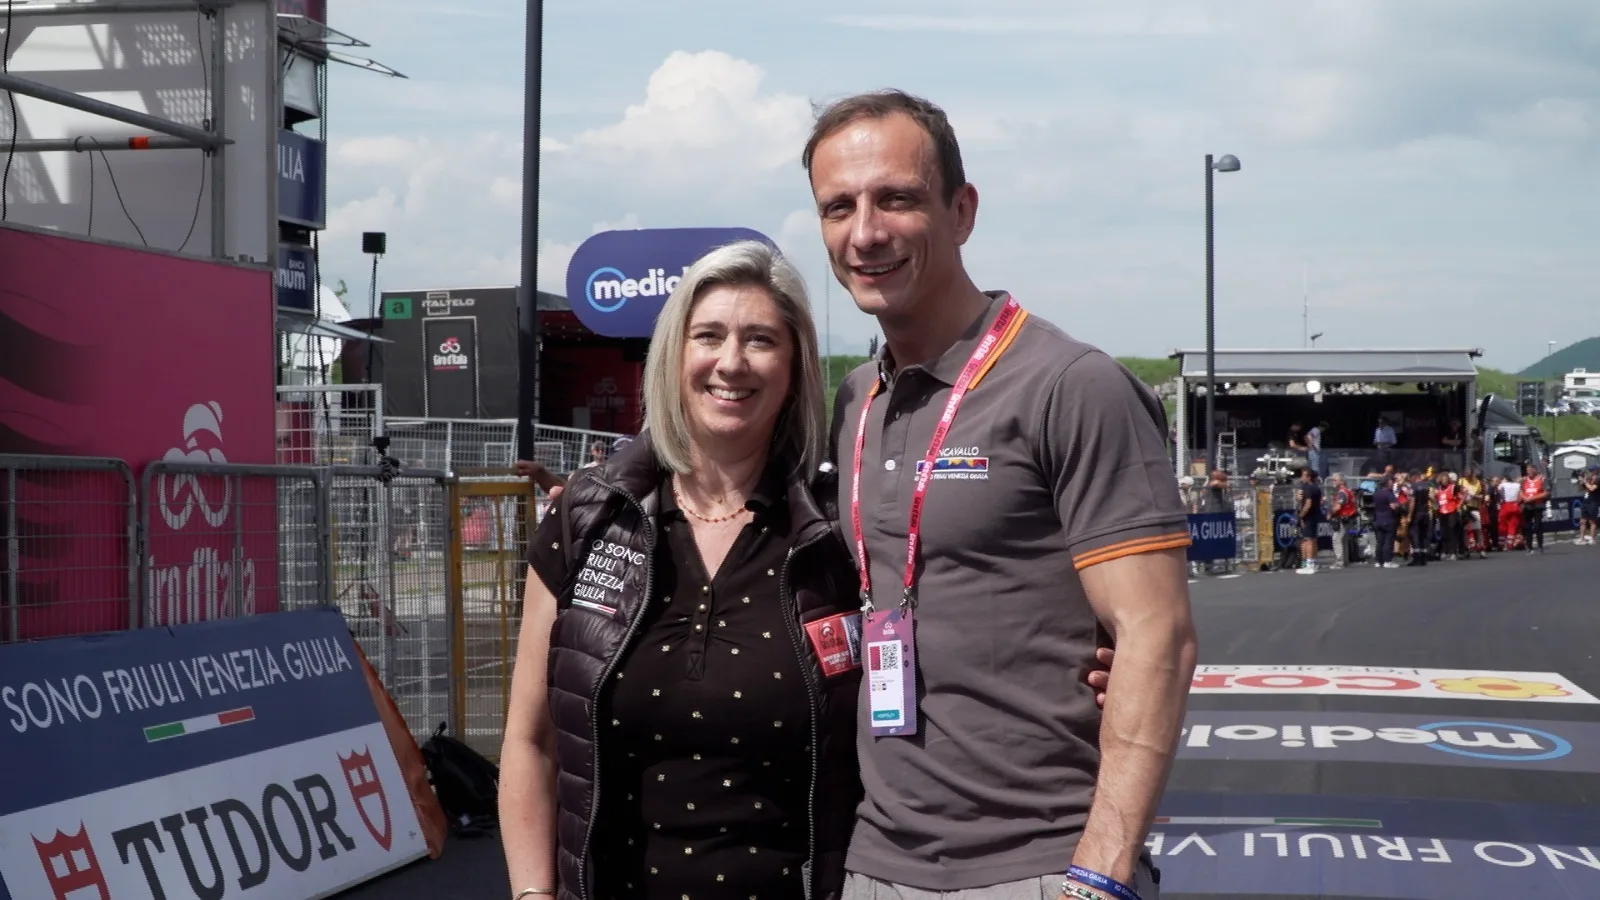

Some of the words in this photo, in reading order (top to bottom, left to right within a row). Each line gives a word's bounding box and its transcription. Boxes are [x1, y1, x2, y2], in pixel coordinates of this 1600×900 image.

[276, 268, 305, 290] num
[392, 301, 405, 314] a
[926, 446, 979, 457] NCAVALLO
[1200, 521, 1235, 540] GIULIA
[587, 553, 617, 571] RIULI
[574, 583, 606, 601] GIULIA
[2, 674, 102, 733] SONO
[102, 661, 186, 714] FRIULI
[179, 645, 288, 699] VENEZIA
[282, 636, 352, 680] GIULIA
[1181, 724, 1544, 749] mediol
[111, 773, 356, 900] TUDOR
[1243, 832, 1452, 863] FRIULI
